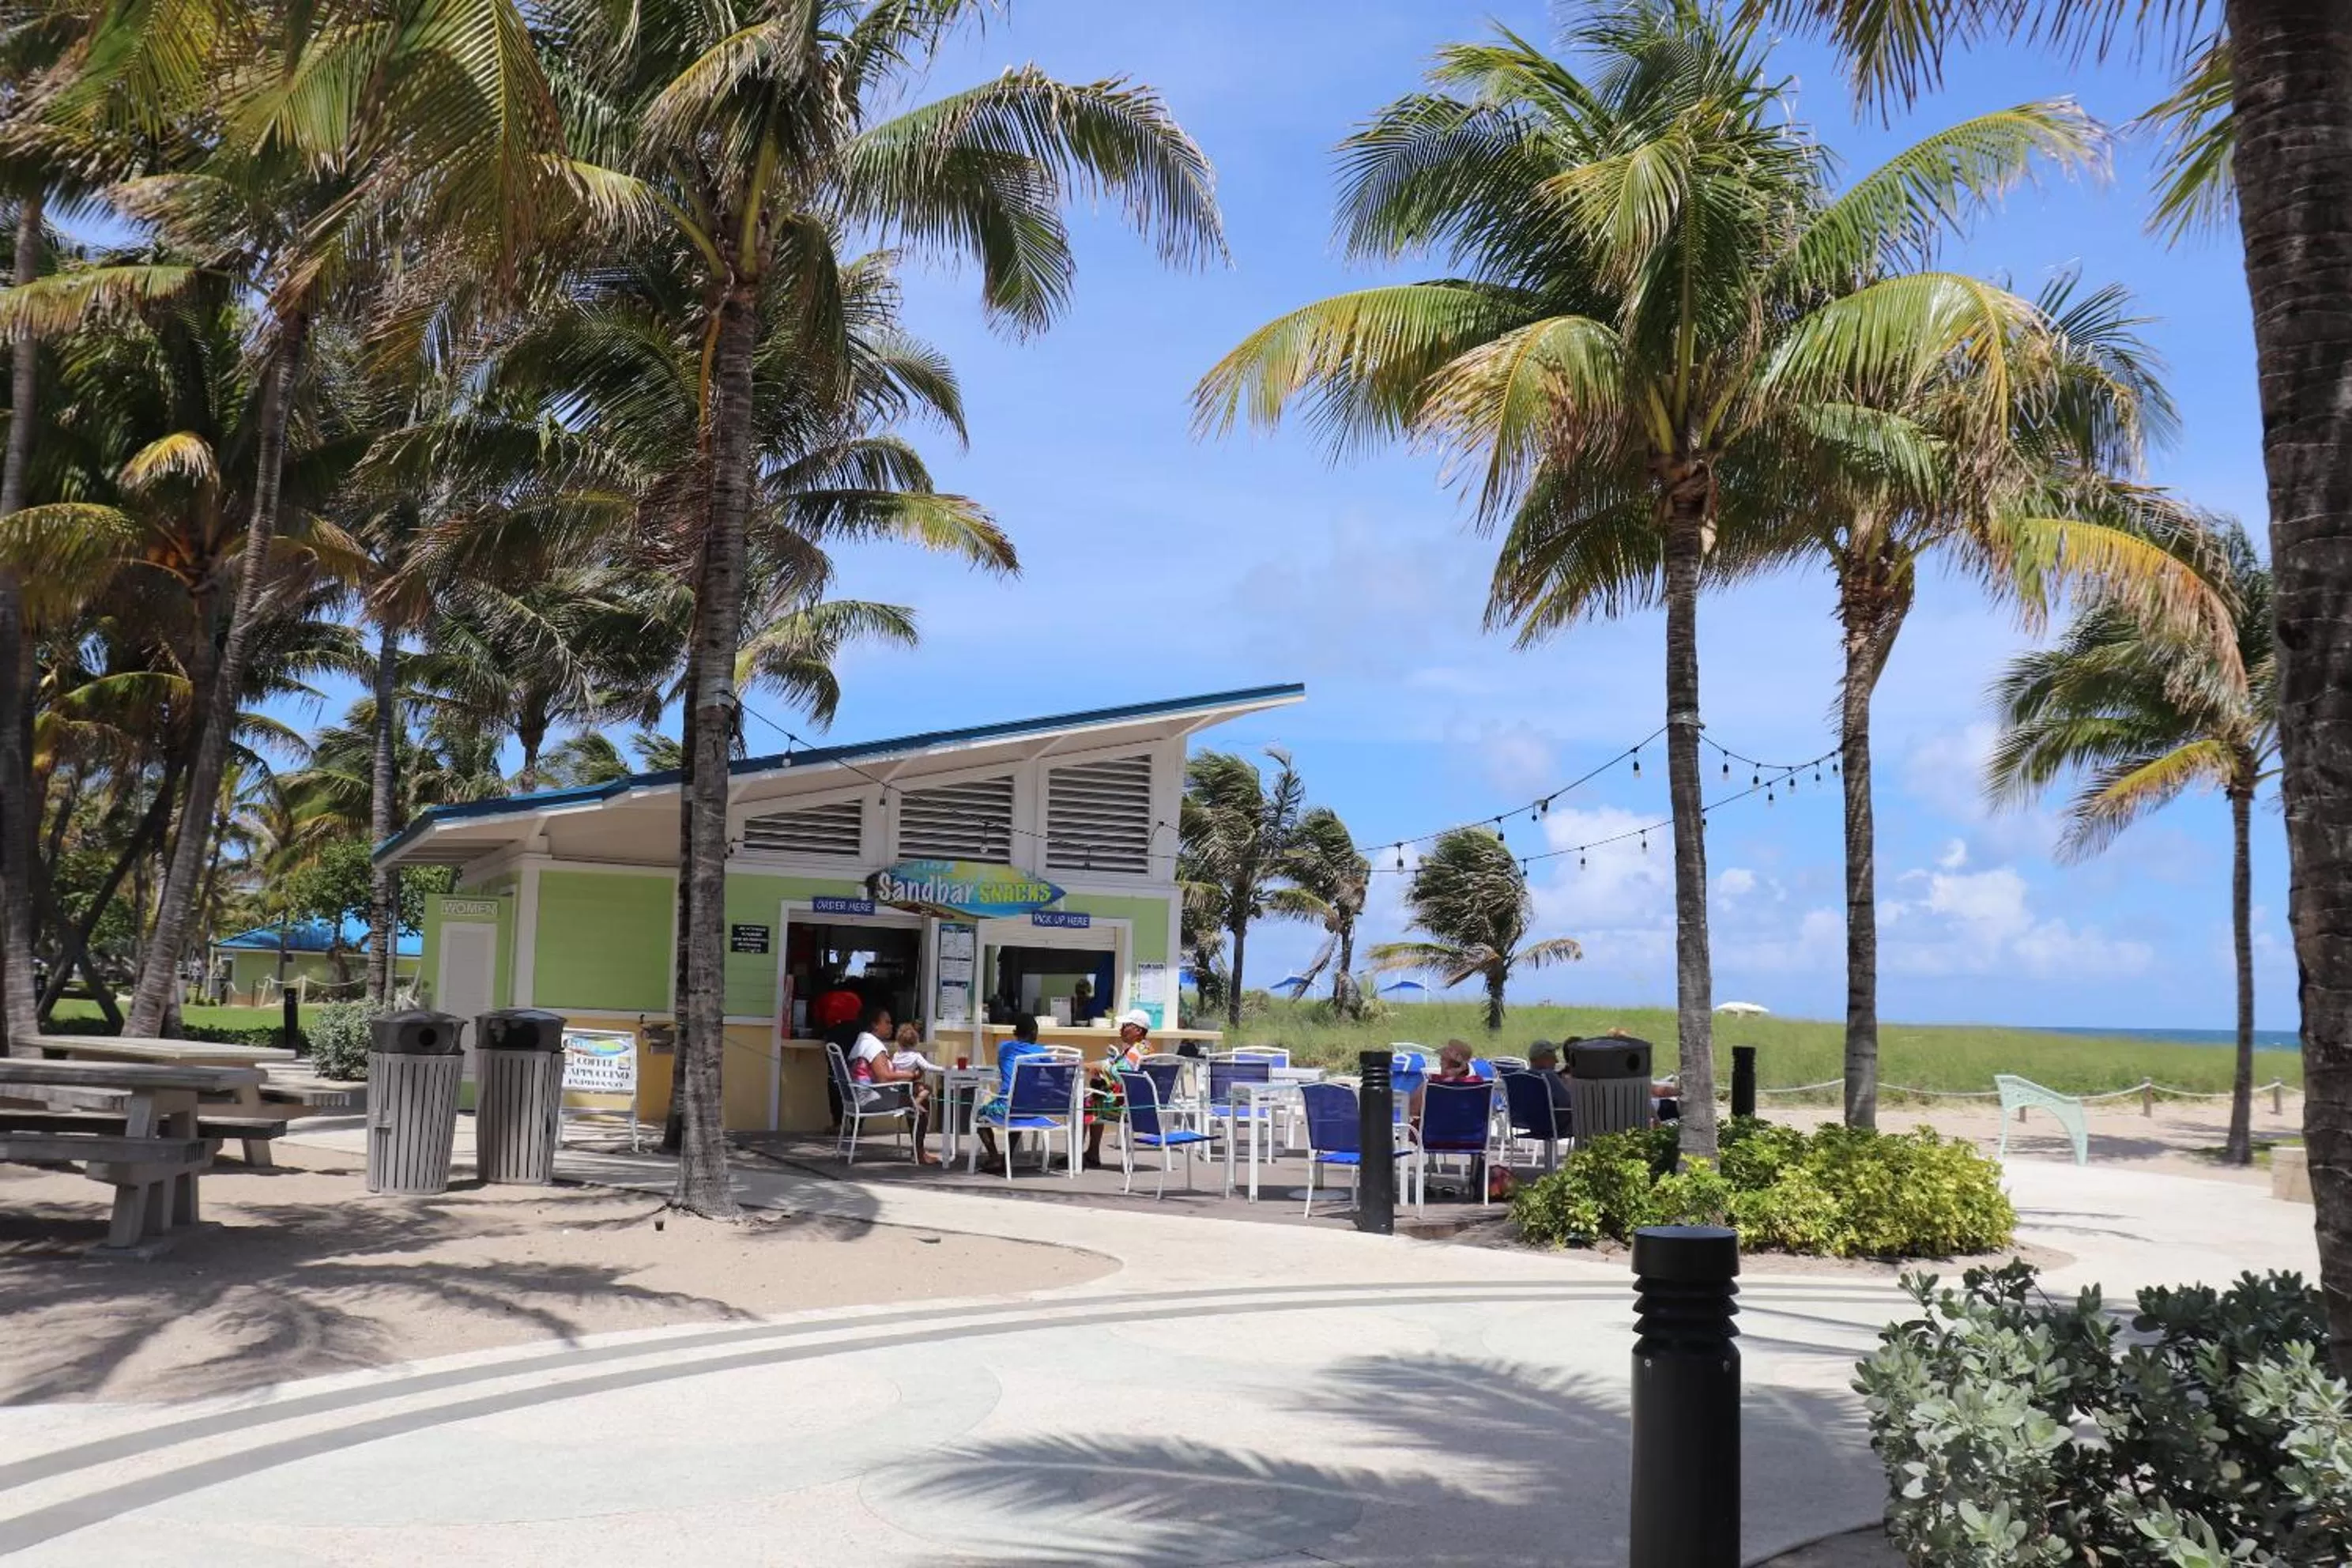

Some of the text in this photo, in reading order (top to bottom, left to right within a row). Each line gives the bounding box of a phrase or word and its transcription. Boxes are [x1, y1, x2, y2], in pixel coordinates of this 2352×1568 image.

[877, 871, 1052, 904] Sandbar SNACKS
[445, 903, 496, 916] WOMEN
[816, 899, 873, 912] ORDER HERE
[1035, 913, 1088, 926] PICK UP HERE
